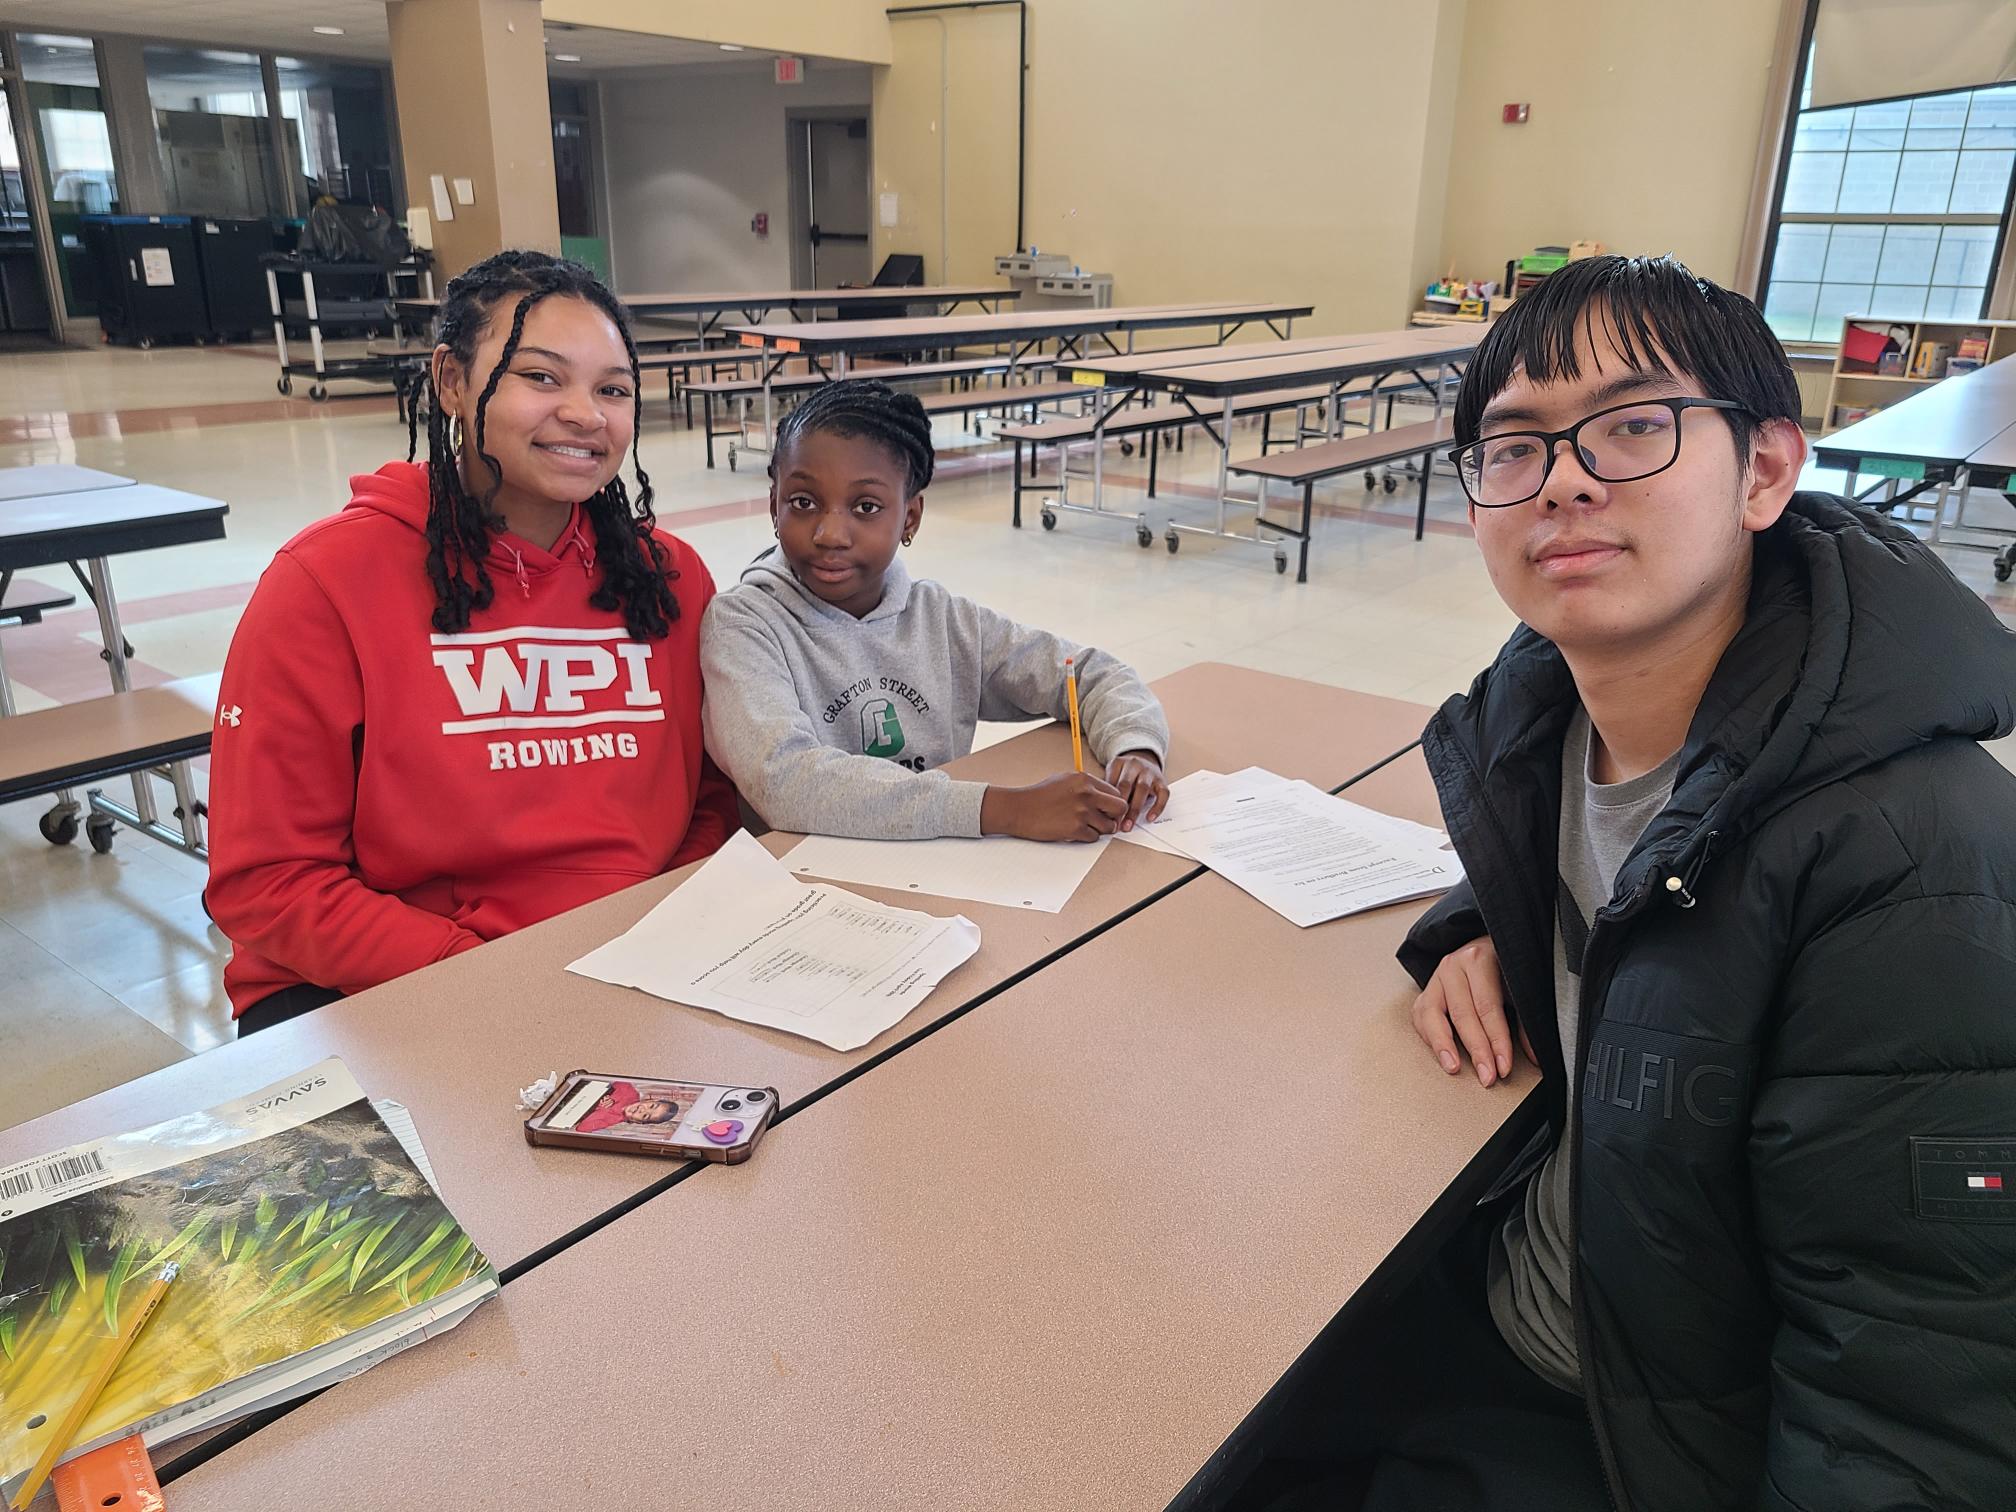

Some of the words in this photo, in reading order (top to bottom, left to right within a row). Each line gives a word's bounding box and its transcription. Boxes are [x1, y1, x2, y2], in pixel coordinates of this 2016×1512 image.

[432, 643, 662, 716] WPI
[823, 677, 872, 724] GRAFTON
[880, 677, 930, 714] STREET
[488, 732, 639, 771] ROWING
[246, 1077, 327, 1116] SAVVAS
[42, 1151, 67, 1162] SCOTT
